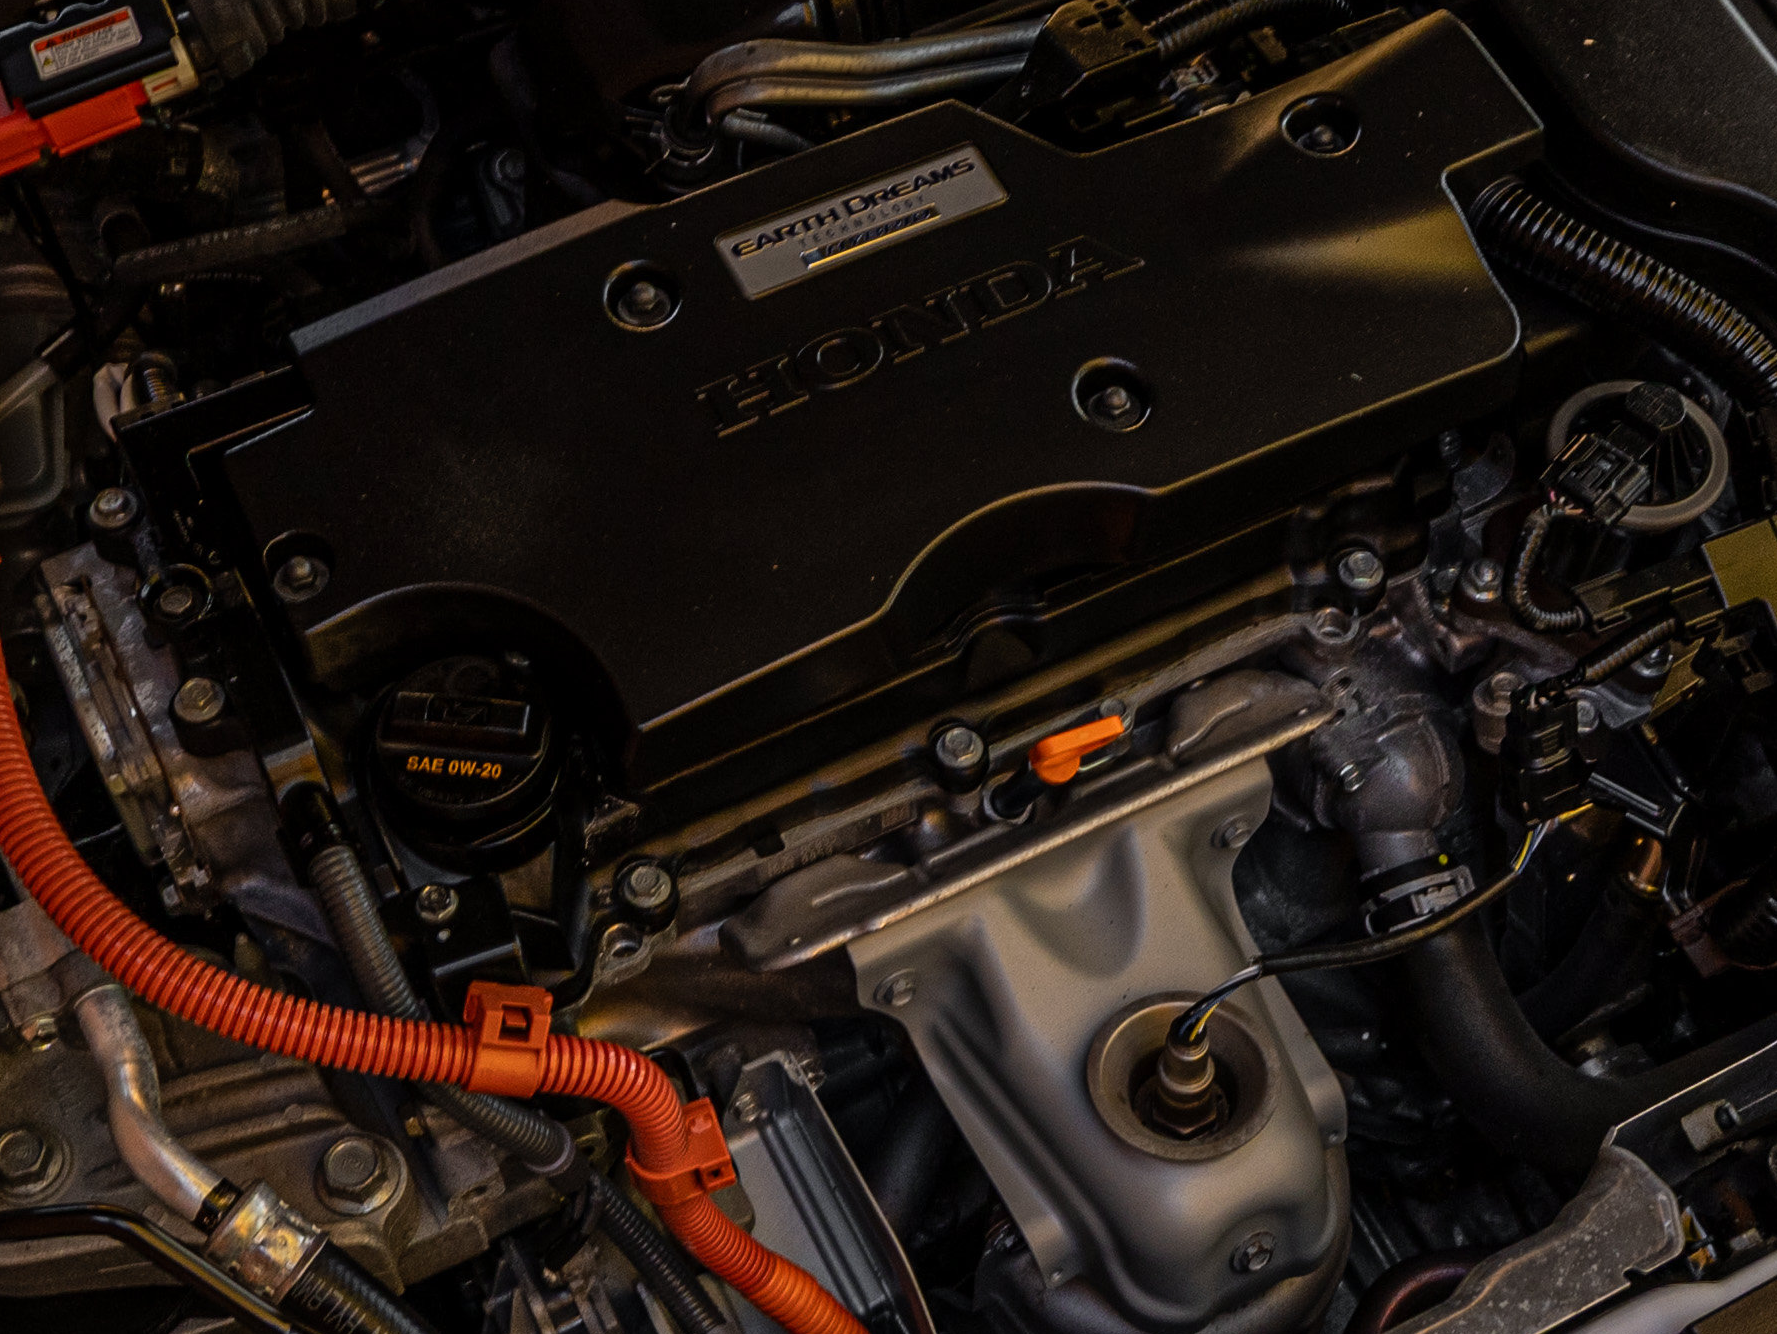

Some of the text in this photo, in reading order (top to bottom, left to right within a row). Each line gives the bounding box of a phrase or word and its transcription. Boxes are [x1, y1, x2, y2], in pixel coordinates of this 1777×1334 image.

[731, 157, 977, 259] EARTH DREAMS
[798, 195, 924, 248] TECHNOLOGY
[695, 234, 1146, 437] HONDA
[406, 755, 502, 779] SAE 0W-20
